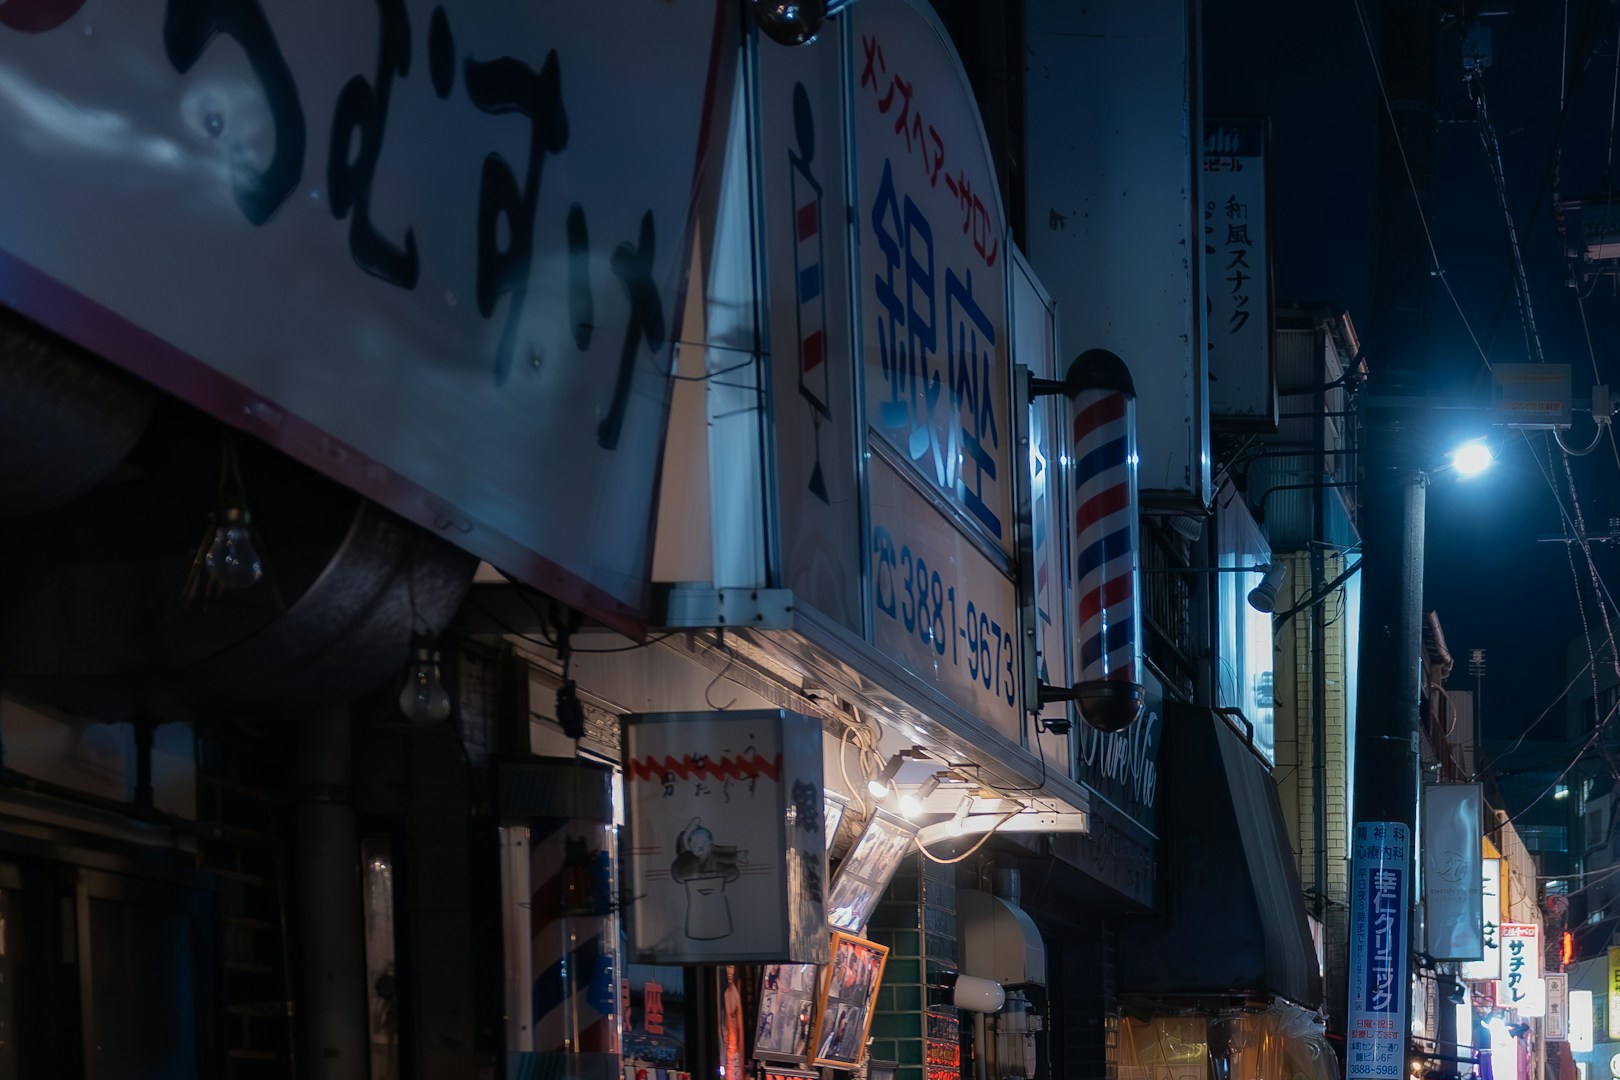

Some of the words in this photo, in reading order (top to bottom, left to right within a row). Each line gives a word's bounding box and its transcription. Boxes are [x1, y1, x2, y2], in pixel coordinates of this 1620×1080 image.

[860, 33, 999, 268] メンズヘアーサロン
[1224, 194, 1253, 336] 和風スナック
[870, 157, 1003, 539] 銀座
[899, 545, 1016, 708] 3881-9673
[1357, 845, 1404, 861] 心療内科
[1372, 870, 1397, 1010] 幸仁クリニック
[1508, 939, 1526, 1003] サチアレ
